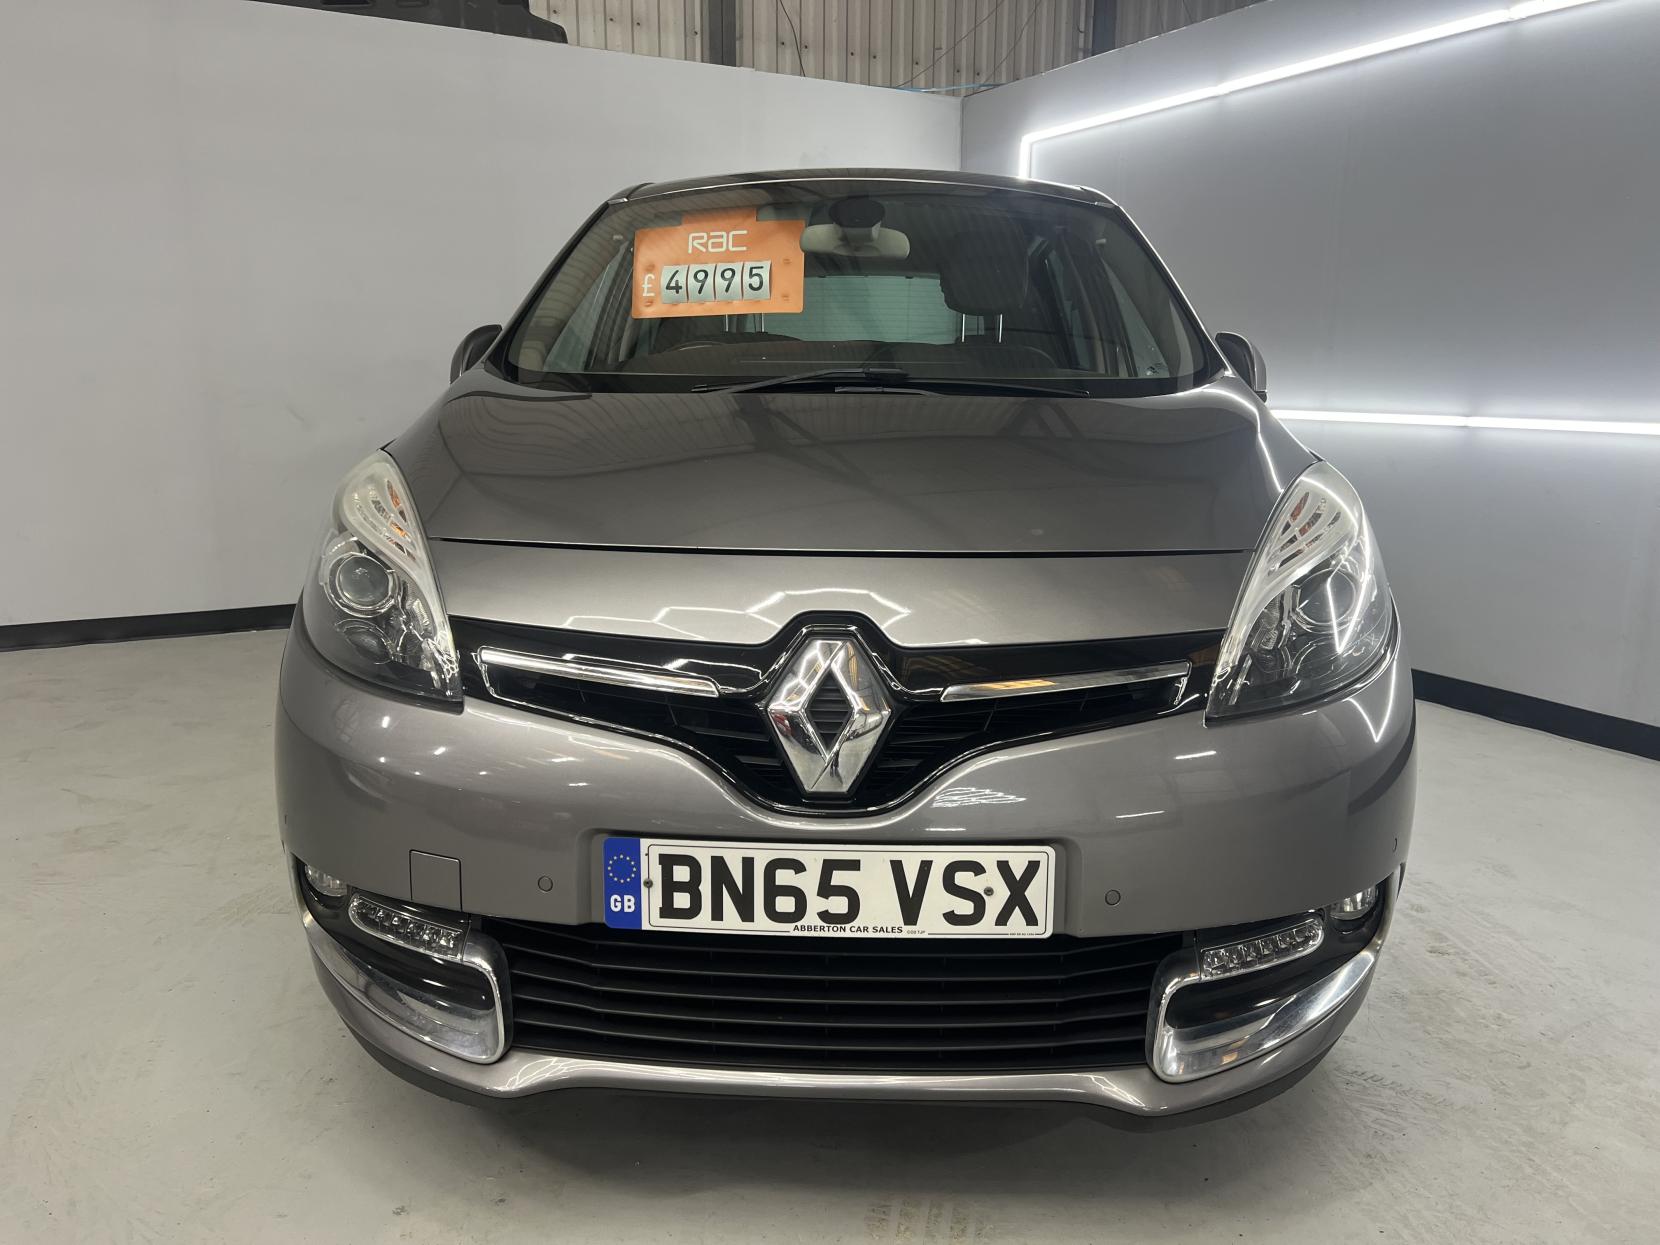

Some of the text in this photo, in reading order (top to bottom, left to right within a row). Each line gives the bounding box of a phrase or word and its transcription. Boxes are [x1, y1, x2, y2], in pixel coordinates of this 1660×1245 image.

[658, 853, 1041, 927] BN65 VSX
[610, 894, 636, 913] GB
[792, 924, 847, 933] ABBERTON
[849, 925, 869, 933] CAR
[872, 926, 903, 934] SALES
